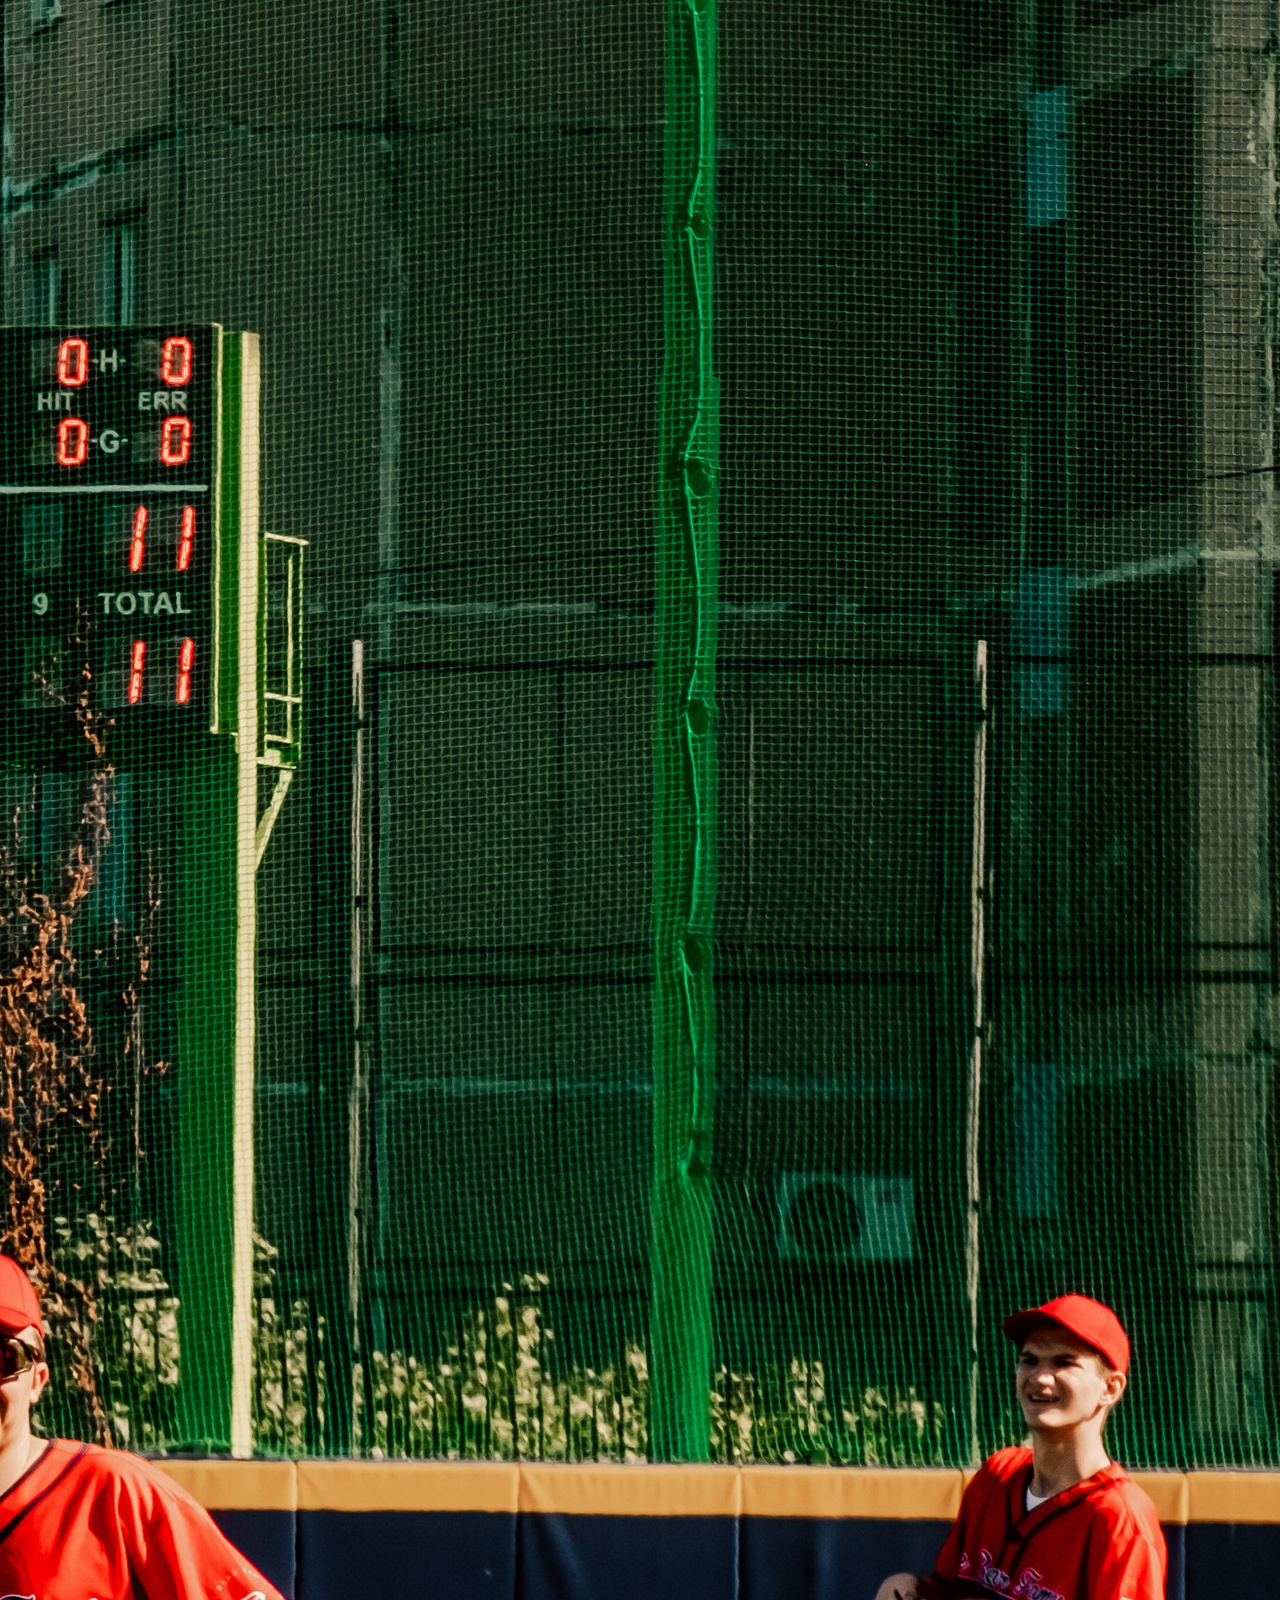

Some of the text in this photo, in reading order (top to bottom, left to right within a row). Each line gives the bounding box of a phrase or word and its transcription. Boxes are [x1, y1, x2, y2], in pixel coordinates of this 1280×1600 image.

[57, 337, 89, 387] 0
[160, 336, 193, 387] 0
[38, 392, 74, 411] HIT
[138, 390, 187, 410] ERR
[56, 416, 90, 467] 0
[159, 415, 192, 466] 0
[34, 593, 48, 615] 9
[98, 591, 191, 615] TOTAL
